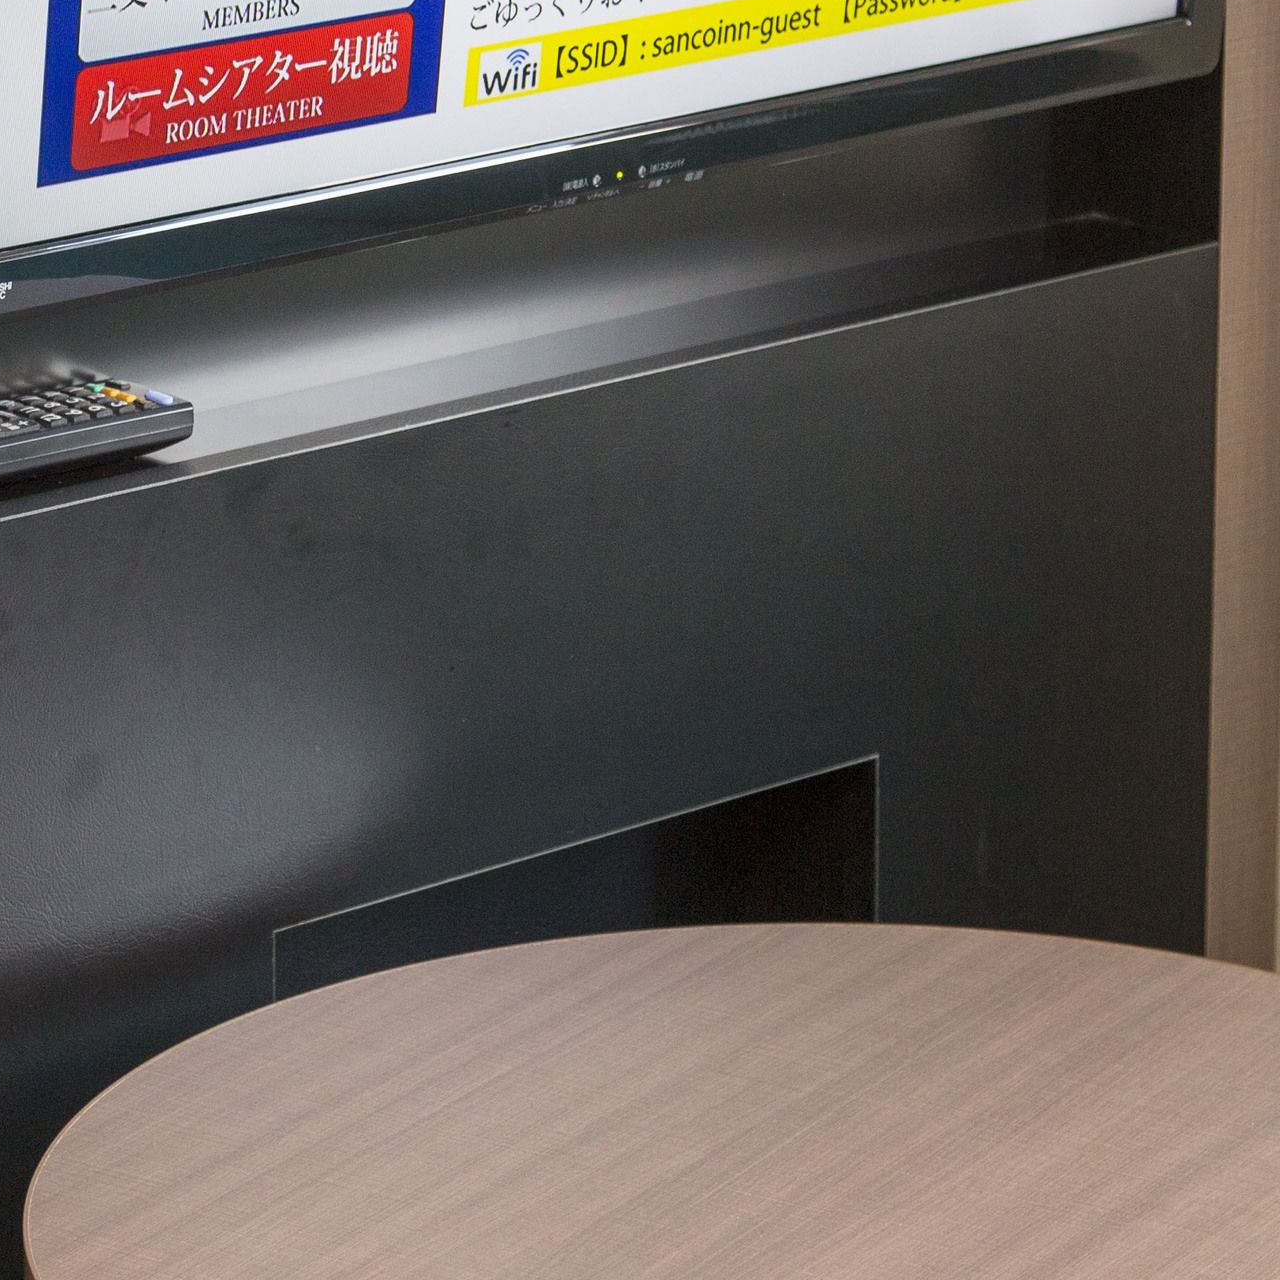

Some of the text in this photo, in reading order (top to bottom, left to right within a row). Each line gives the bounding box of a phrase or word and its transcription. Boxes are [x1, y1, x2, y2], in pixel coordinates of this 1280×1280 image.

[89, 28, 400, 126] ルームシアター視聴
[165, 95, 325, 145] ROOM THEATER
